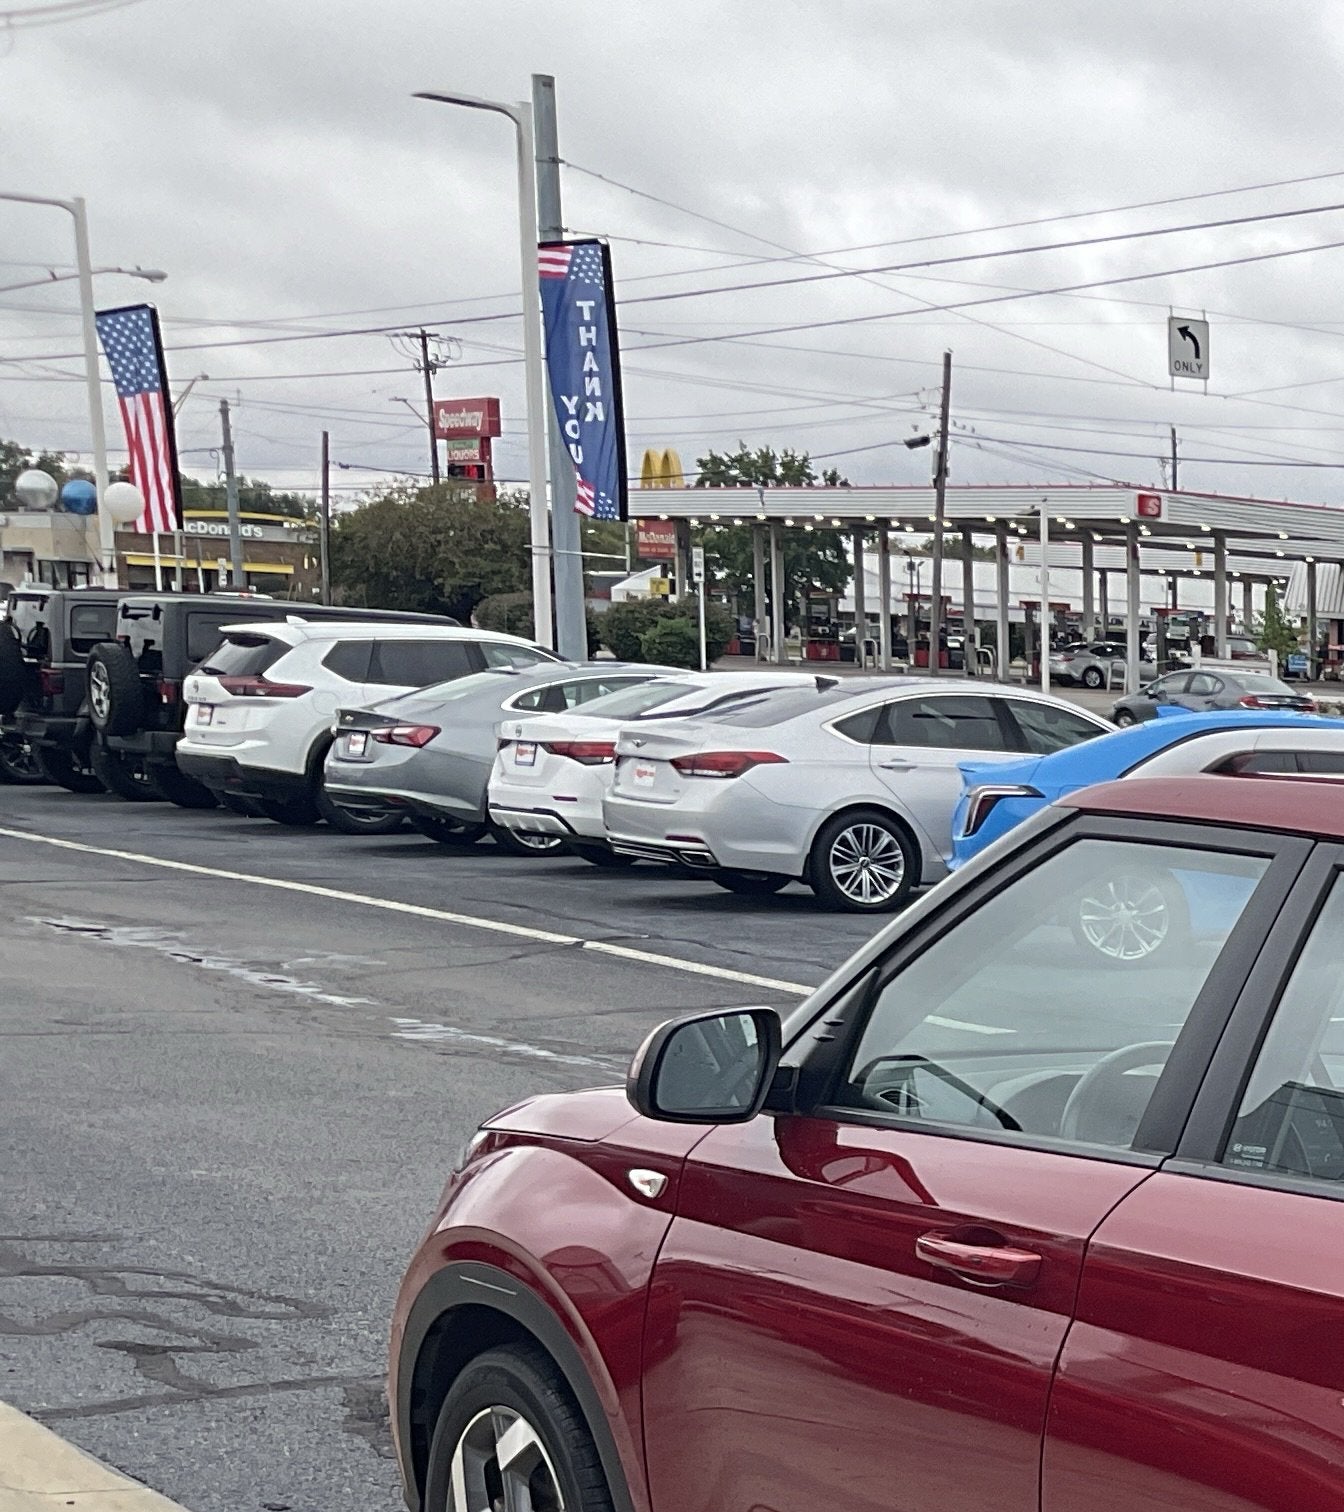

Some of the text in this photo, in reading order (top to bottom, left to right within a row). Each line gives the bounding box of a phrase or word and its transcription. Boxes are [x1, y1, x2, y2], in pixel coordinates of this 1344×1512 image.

[1173, 359, 1203, 374] ONLY
[438, 408, 484, 434] Speedway
[447, 449, 480, 461] LIQUORS
